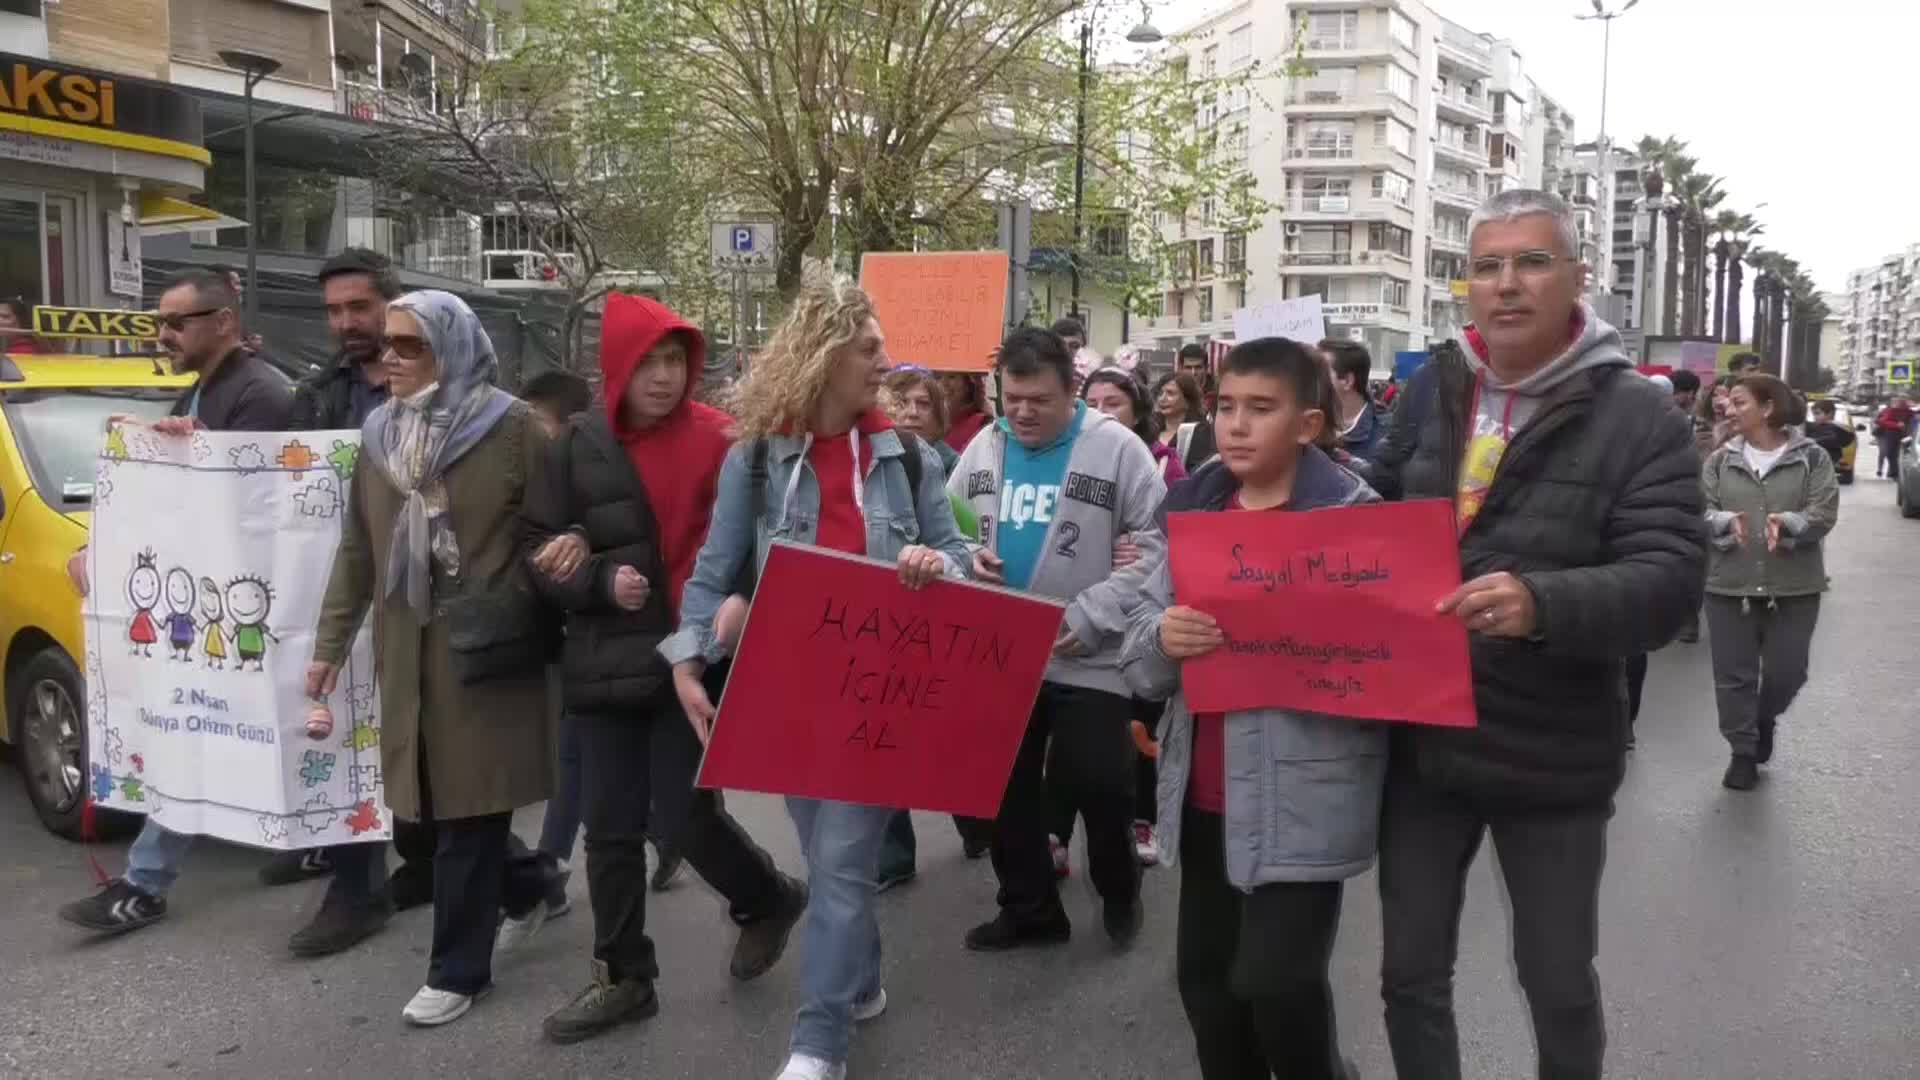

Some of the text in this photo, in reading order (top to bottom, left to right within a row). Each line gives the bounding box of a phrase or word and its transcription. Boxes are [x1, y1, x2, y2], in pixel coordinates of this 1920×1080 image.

[736, 229, 750, 249] P
[40, 310, 157, 336] TAKS
[1056, 520, 1081, 559] 2
[1231, 544, 1294, 592] Sosyal
[808, 596, 1016, 673] HAYATIN
[173, 687, 184, 705] 2
[840, 656, 950, 710] İÇİNE
[186, 715, 233, 737] Otizm
[236, 722, 276, 745] Günü
[845, 719, 898, 752] AL
